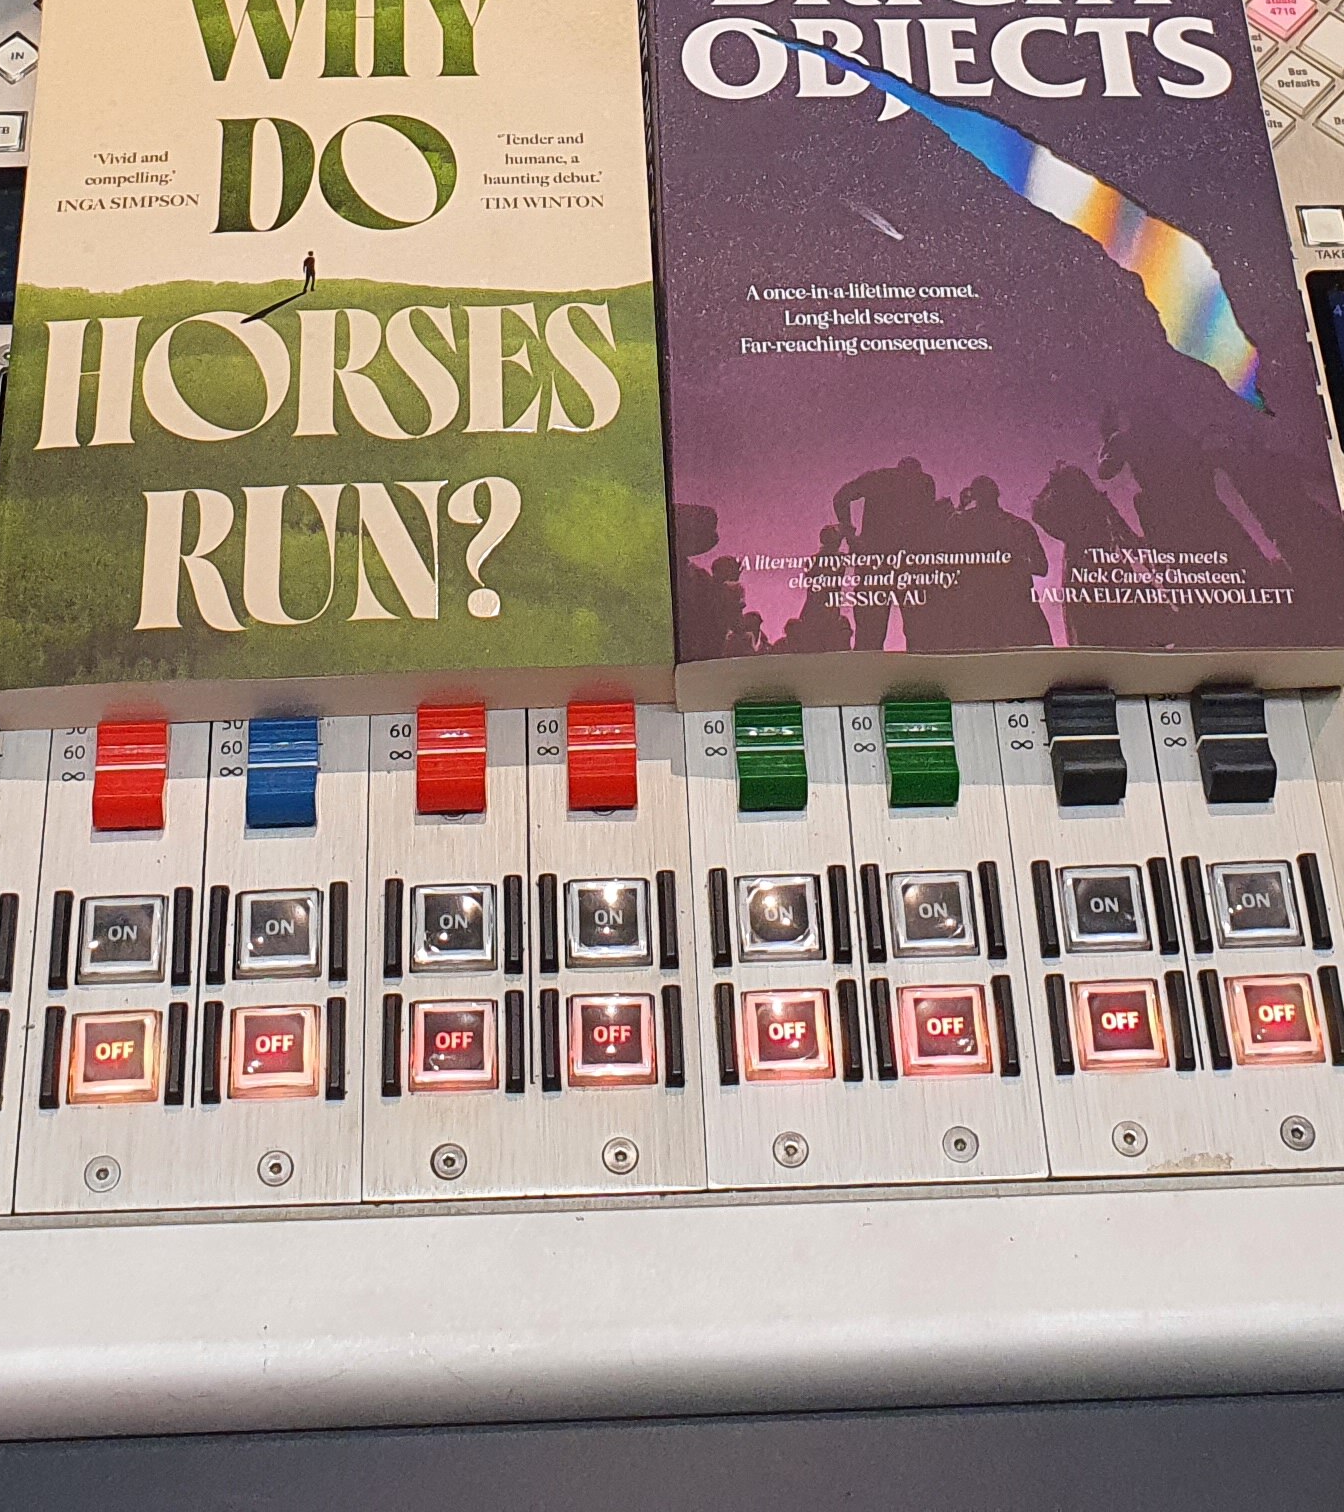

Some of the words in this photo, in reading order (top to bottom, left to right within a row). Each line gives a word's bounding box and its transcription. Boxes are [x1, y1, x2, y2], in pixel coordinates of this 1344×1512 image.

[681, 16, 1233, 121] OBJECTS
[557, 133, 584, 144] and
[141, 151, 168, 163] and
[505, 153, 567, 165] humane,
[571, 155, 580, 163] a
[209, 114, 458, 234] DO
[483, 173, 549, 187] haunting
[57, 198, 105, 212] INGA
[110, 194, 200, 209] SIMPSON
[481, 197, 518, 209] TIM
[523, 195, 604, 208] WINTON
[746, 284, 759, 300] A
[763, 283, 920, 301] once-in-a-lifetime
[919, 283, 979, 300] comet.
[784, 309, 871, 329] Long-held
[874, 311, 944, 326] secrets.
[740, 335, 858, 355] Far-reaching
[860, 336, 993, 354] consequences.
[33, 302, 622, 451] HORSES
[133, 476, 522, 633] RUN?
[755, 555, 816, 571] literary
[819, 554, 884, 570] mystery
[887, 550, 905, 568] of
[906, 549, 1011, 567] consummate
[1122, 548, 1175, 564] X-Files
[1178, 550, 1228, 564] meets
[789, 574, 860, 591] elegance
[864, 571, 894, 586] and
[1070, 568, 1108, 583] Nick
[825, 591, 899, 607] JESSICA
[903, 590, 927, 606] AU
[1031, 588, 1091, 603] LAURA
[1094, 588, 1194, 604] ELIZABETH
[1198, 588, 1294, 604] WOOLLETT
[1089, 897, 1120, 914] ON
[107, 924, 138, 942] ON
[1101, 1011, 1139, 1030] OFF
[95, 1040, 135, 1061] OFF
